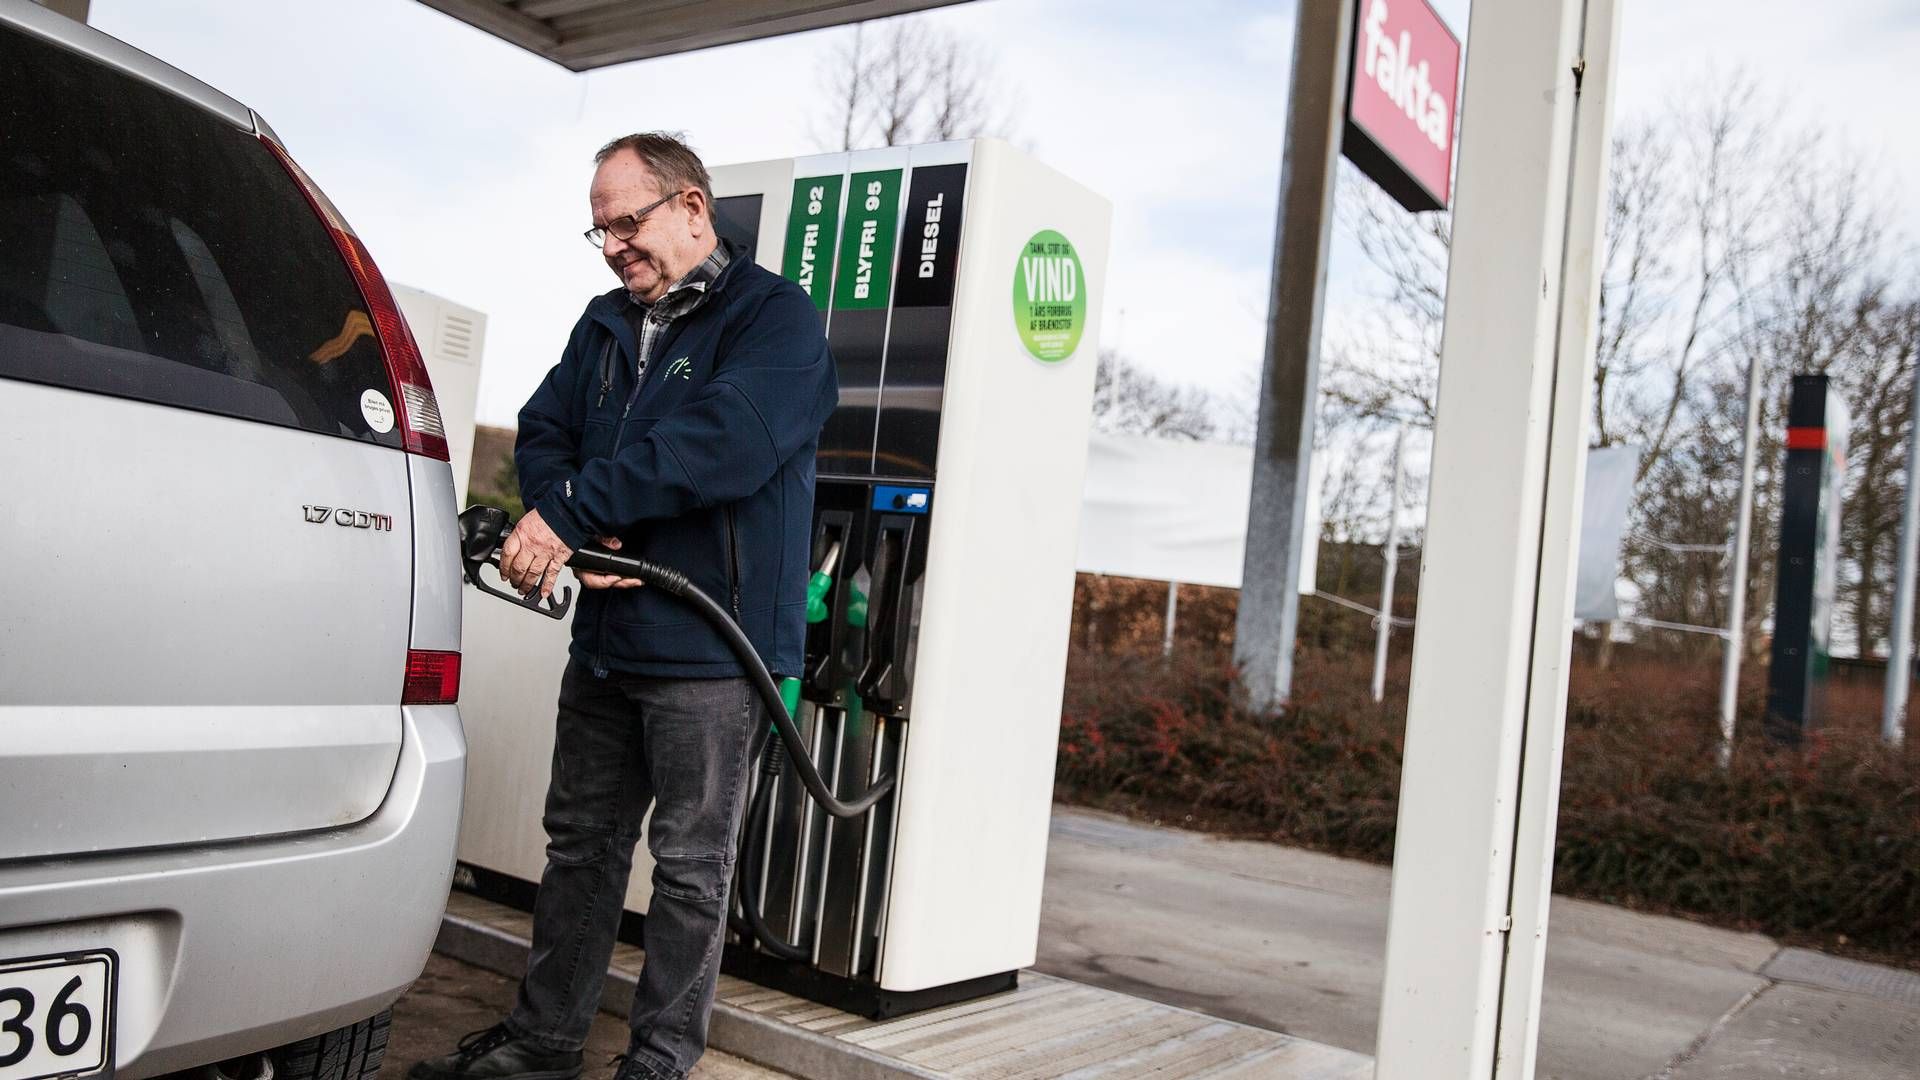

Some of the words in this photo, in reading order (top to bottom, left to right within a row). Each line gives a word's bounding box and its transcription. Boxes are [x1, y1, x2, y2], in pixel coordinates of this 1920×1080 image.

[1365, 0, 1449, 151] fakta
[808, 186, 824, 216] 92
[865, 180, 882, 212] 95
[918, 193, 944, 278] DIESEL
[854, 220, 877, 299] BLYFRI
[1023, 257, 1076, 302] VIND
[335, 509, 392, 531] CDTI
